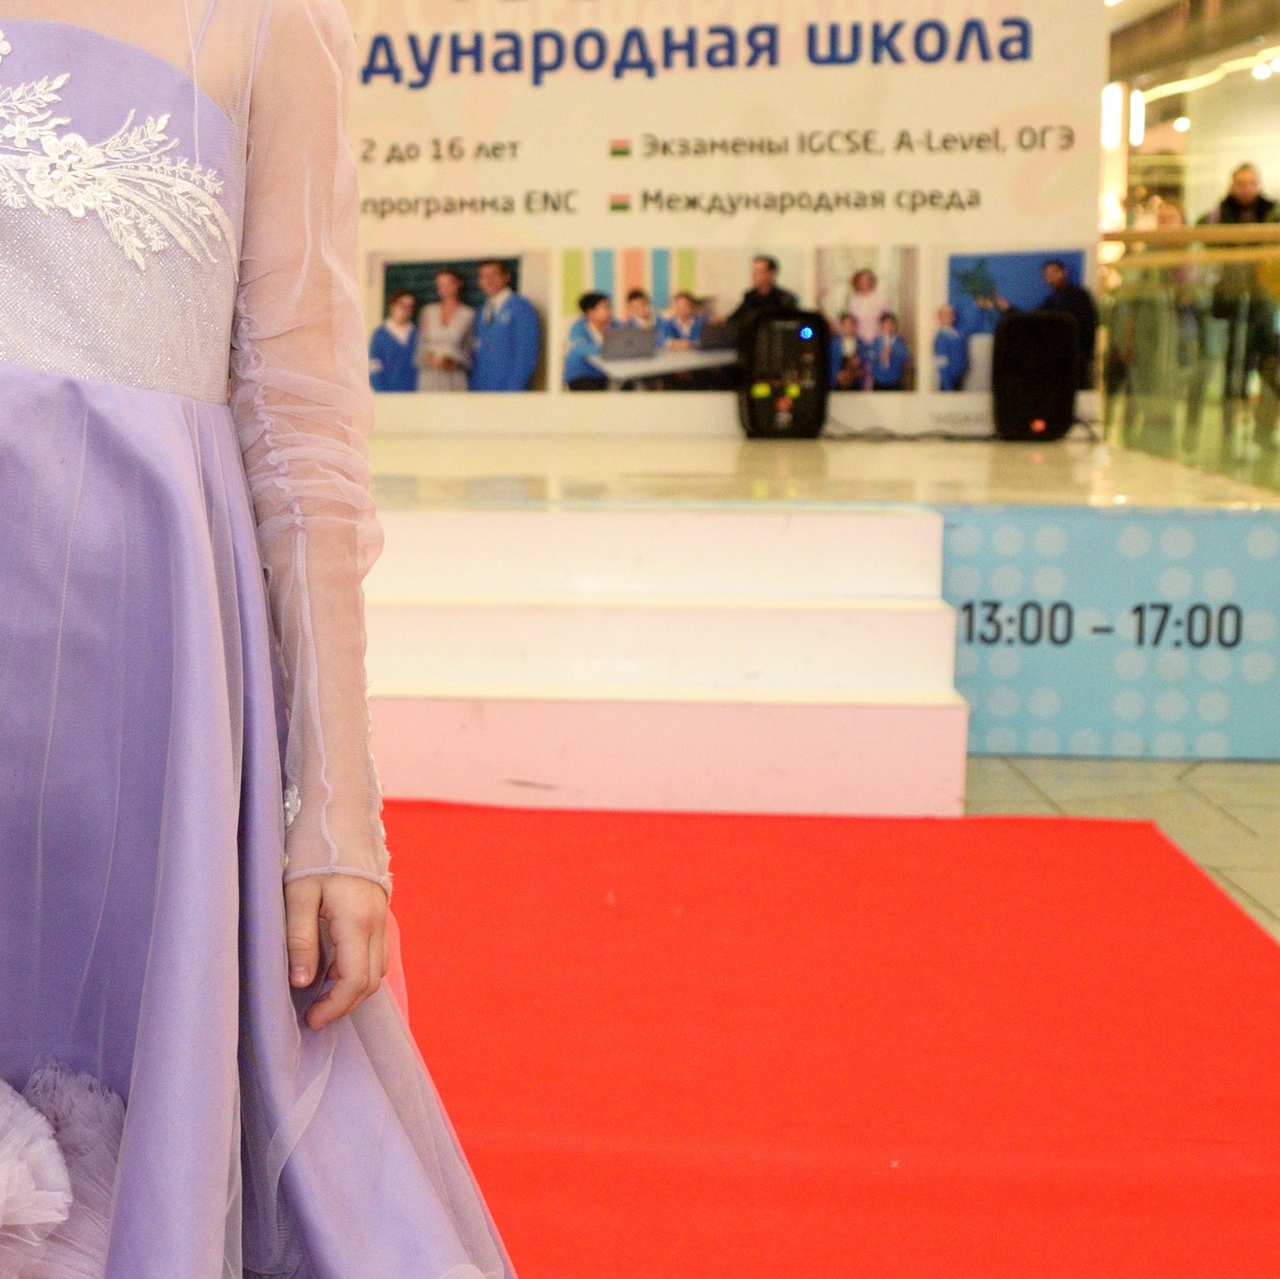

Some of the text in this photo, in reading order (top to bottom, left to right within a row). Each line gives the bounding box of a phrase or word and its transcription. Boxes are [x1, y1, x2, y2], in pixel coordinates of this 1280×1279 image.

[360, 16, 1033, 90] дународная школа
[384, 139, 422, 165] до
[430, 136, 466, 161] 16
[473, 137, 521, 161] лет
[642, 133, 790, 158] Экзамены
[1016, 124, 1076, 152] ОГЭ
[361, 189, 580, 220] программа ENC
[640, 186, 983, 217] Международная среда
[960, 600, 1075, 647] 13:00
[1131, 602, 1244, 649] 17:00
